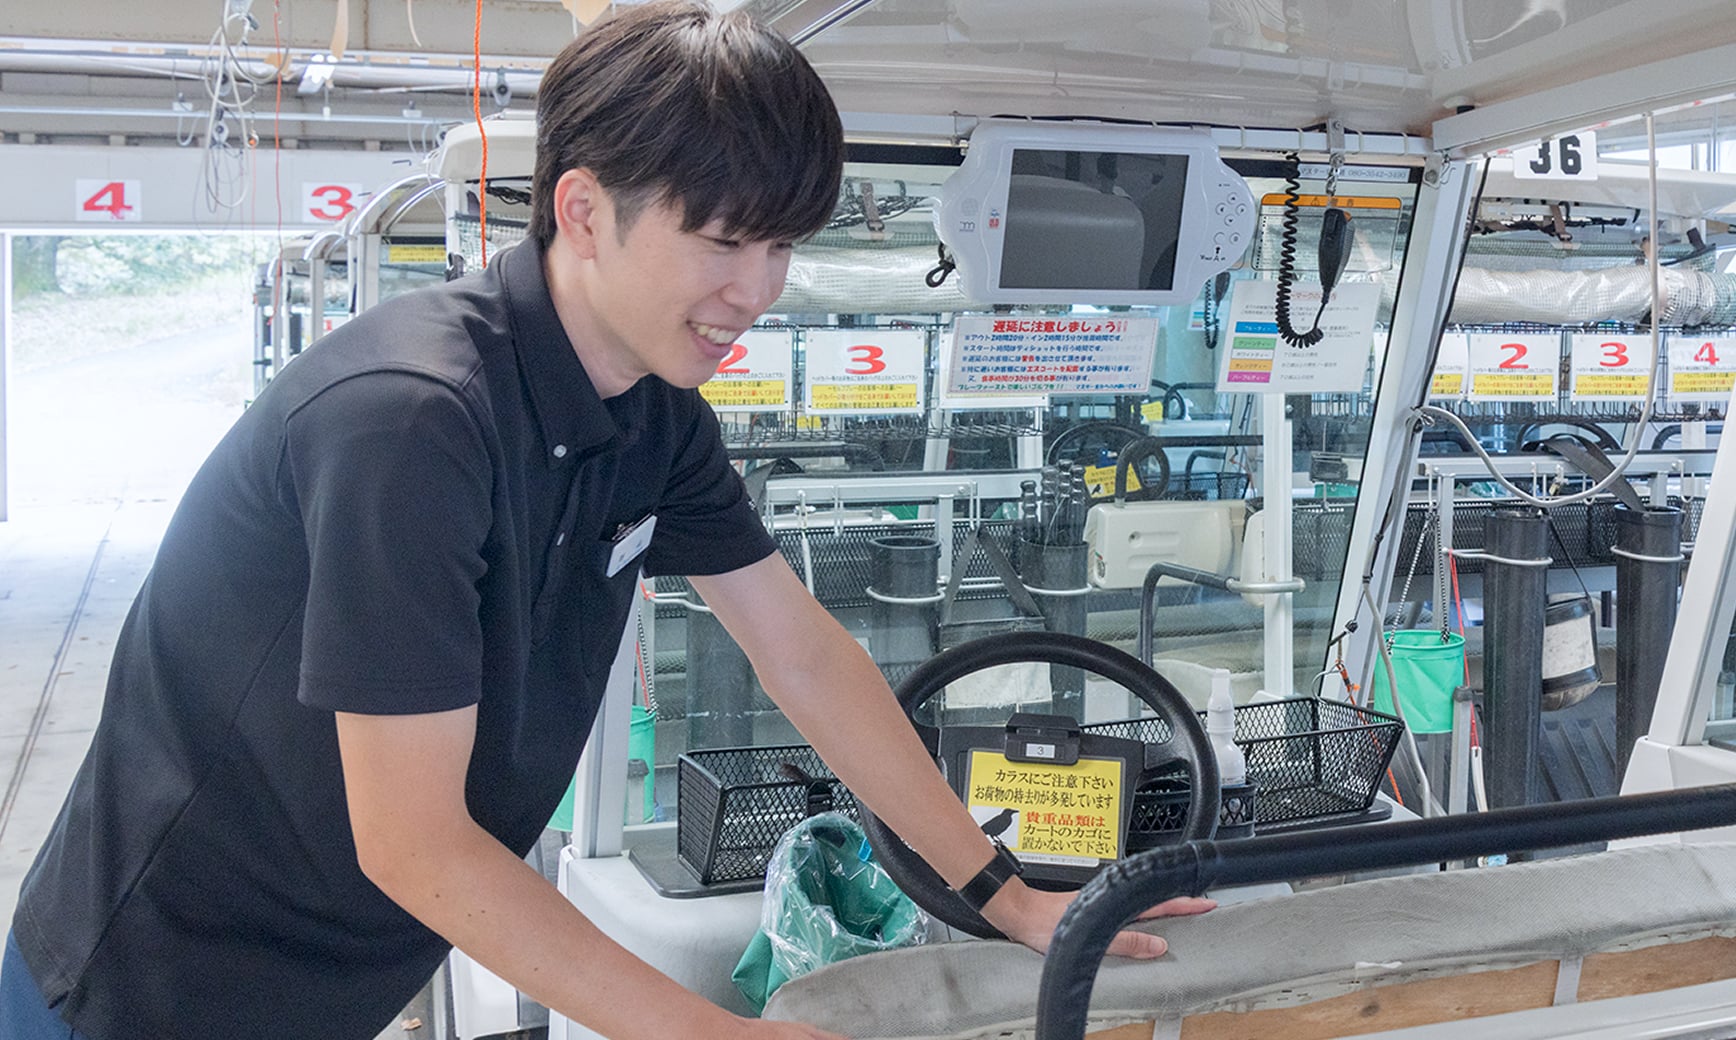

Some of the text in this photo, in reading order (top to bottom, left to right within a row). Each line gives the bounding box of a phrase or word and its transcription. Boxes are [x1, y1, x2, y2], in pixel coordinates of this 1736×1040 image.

[1530, 135, 1582, 175] 36
[83, 182, 133, 219] 4
[309, 185, 356, 221] 3
[715, 344, 750, 373] 2
[845, 345, 886, 375] 3
[1499, 343, 1529, 369] 2
[1600, 342, 1629, 367] 3
[1694, 342, 1720, 365] 4
[1037, 746, 1044, 755] 3
[995, 769, 1114, 789] カラスにご注意下さい
[974, 785, 1113, 810] お荷物の持去りが多発しています
[1026, 811, 1106, 827] 貴重品類は
[1024, 824, 1112, 840] カートのカゴに
[1022, 836, 1116, 855] 置かないで下さい
